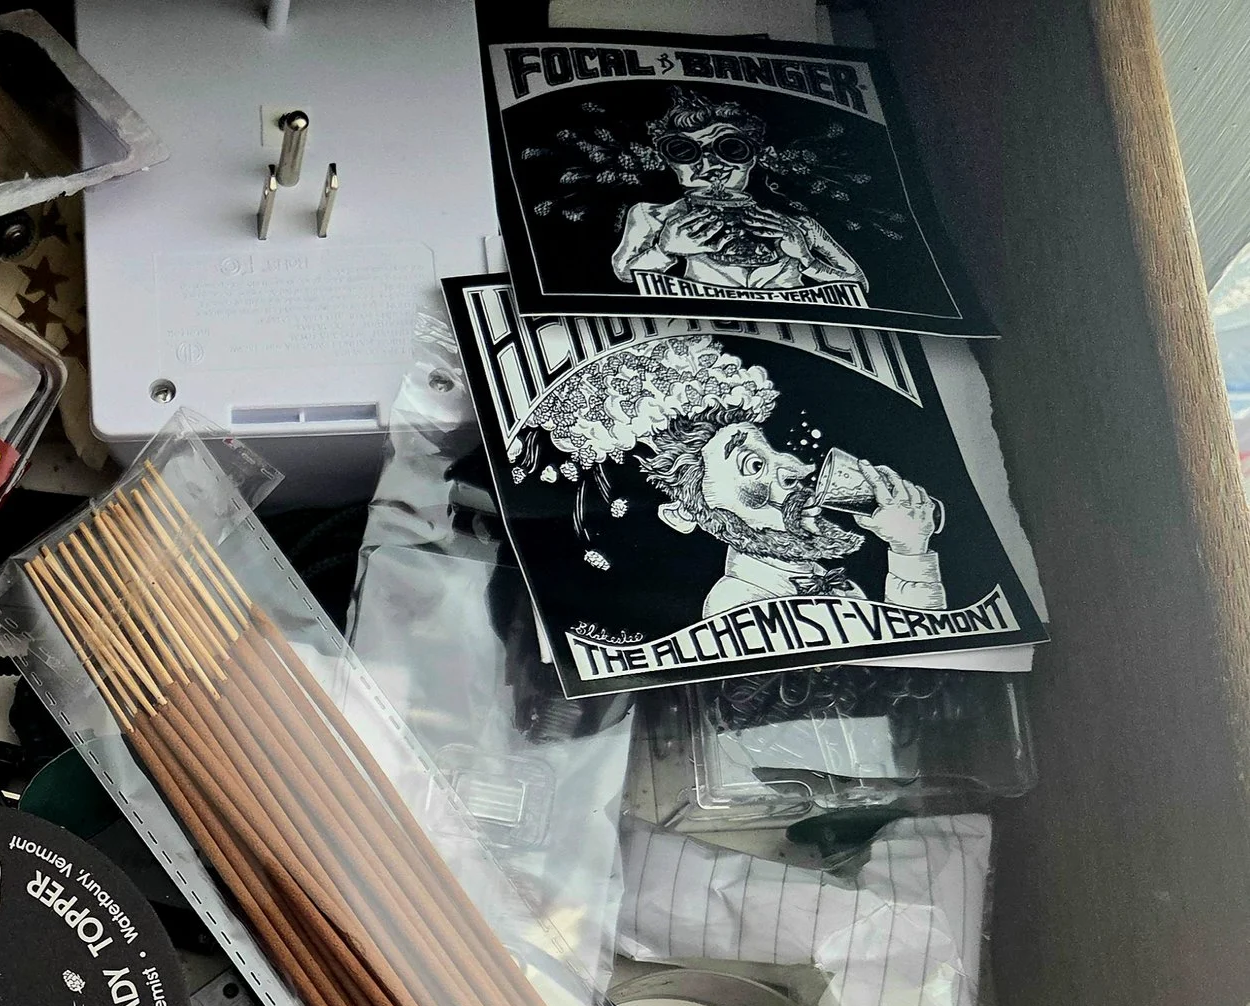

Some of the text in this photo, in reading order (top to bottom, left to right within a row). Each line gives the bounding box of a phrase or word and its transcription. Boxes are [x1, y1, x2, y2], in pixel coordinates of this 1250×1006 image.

[505, 48, 868, 114] FOCAL BANGER
[638, 273, 679, 296] THE
[574, 637, 648, 675] THE
[9, 835, 73, 878] Vermont
[26, 870, 114, 958] TOPPER
[76, 869, 139, 945] Waterbury,
